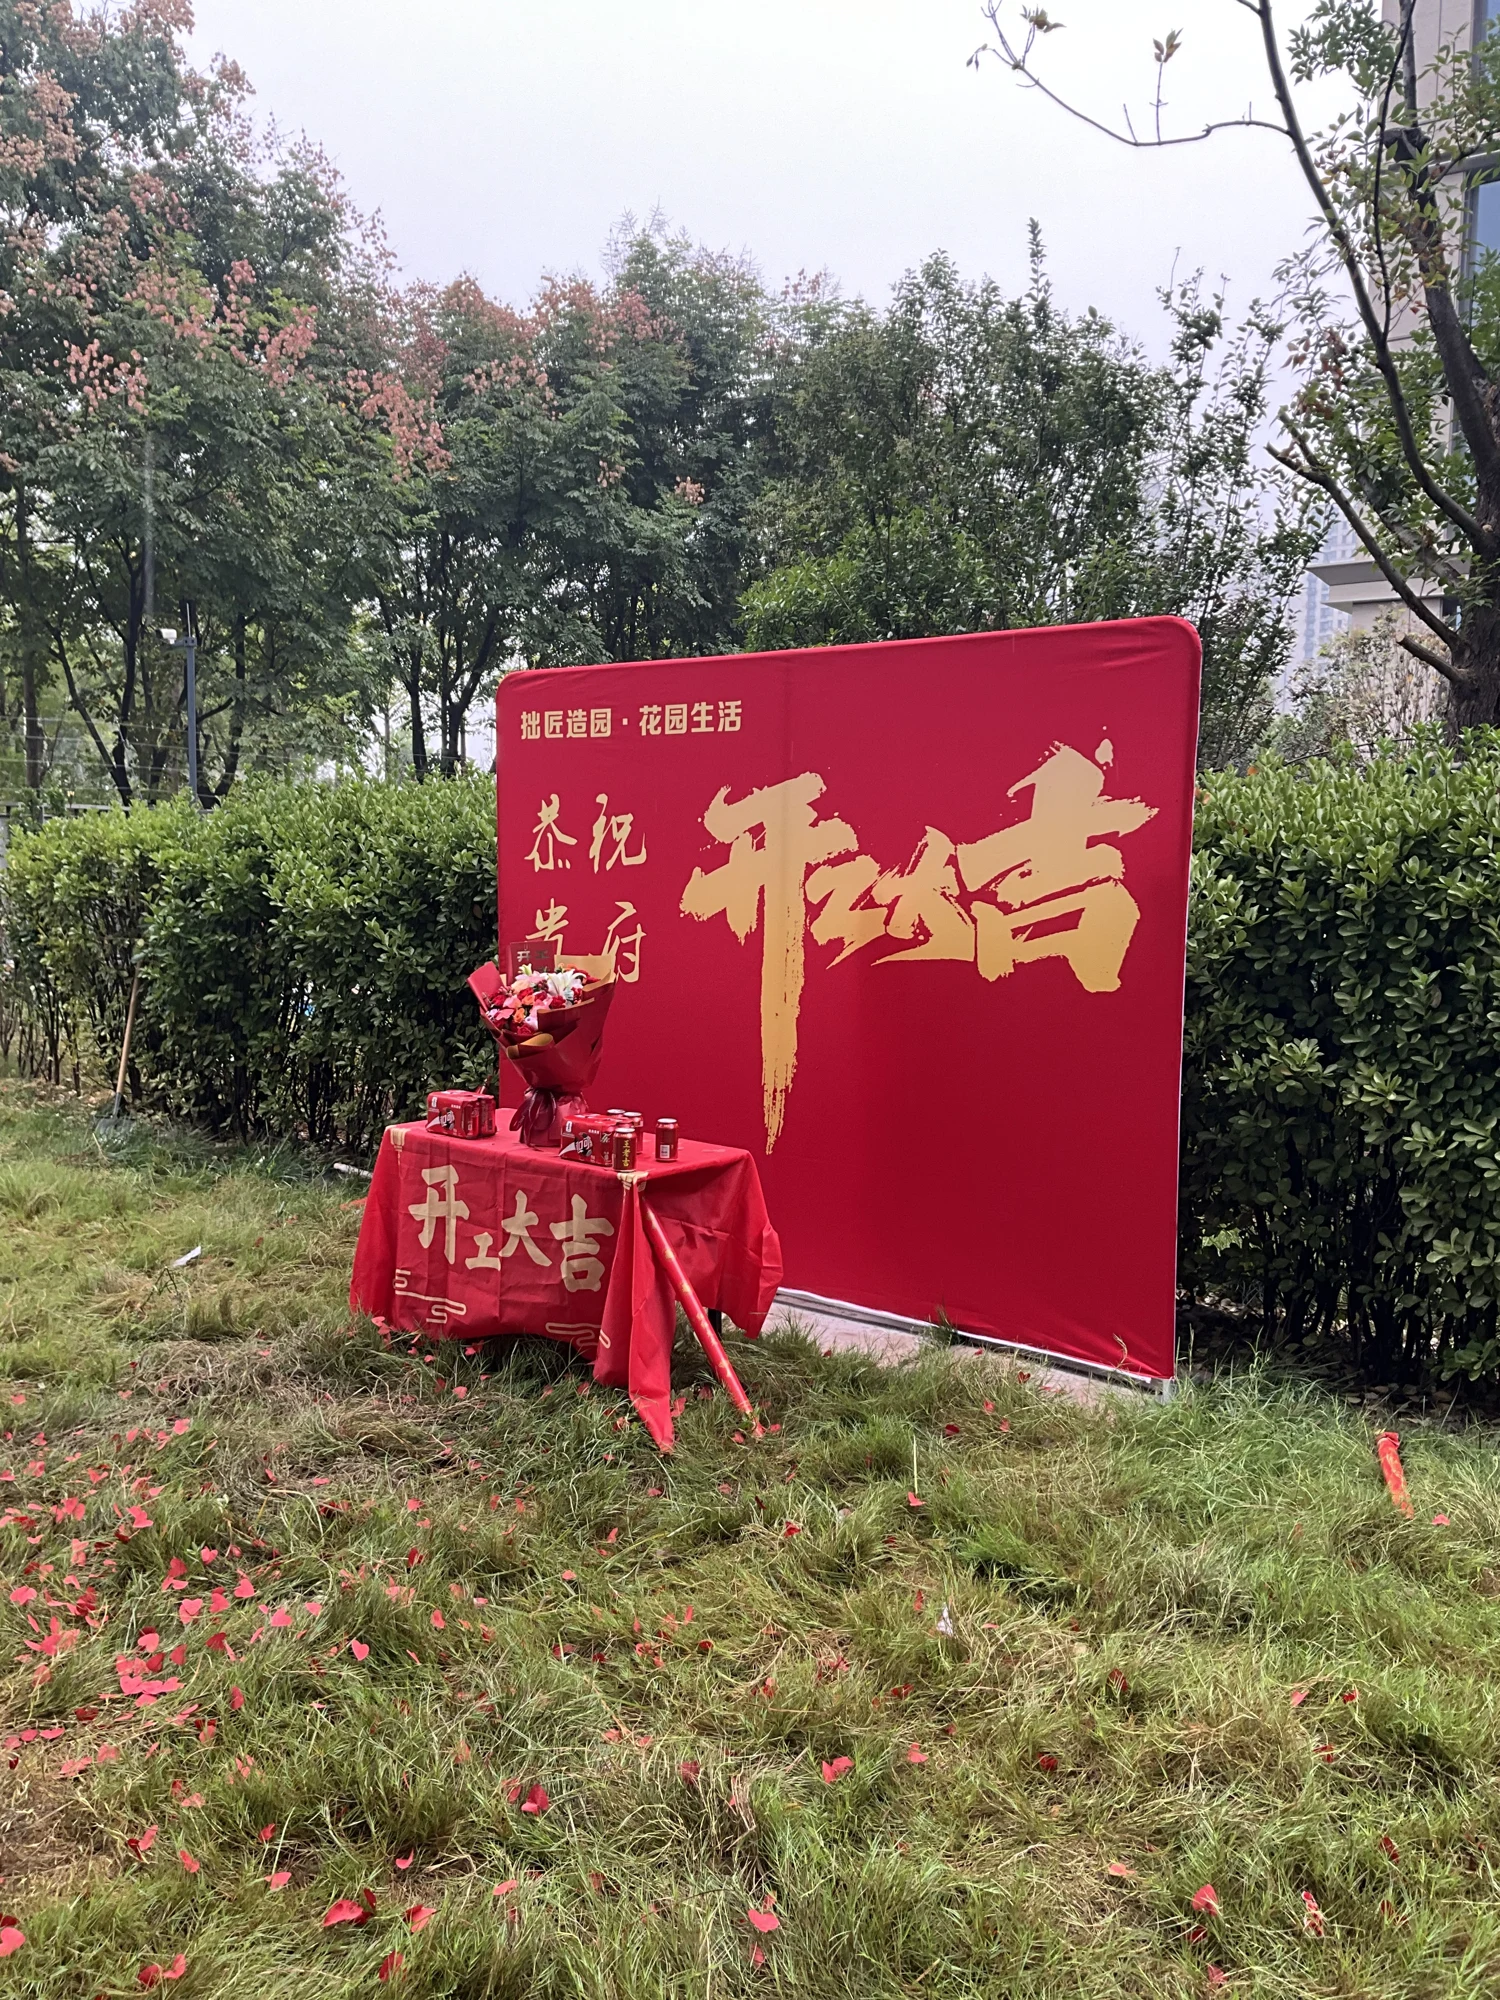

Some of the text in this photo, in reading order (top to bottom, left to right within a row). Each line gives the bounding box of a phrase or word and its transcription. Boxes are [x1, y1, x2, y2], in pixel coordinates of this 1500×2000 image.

[524, 793, 647, 873] 恭祝
[680, 738, 1160, 1155] 开工大吉
[407, 1164, 614, 1293] 开工大吉
